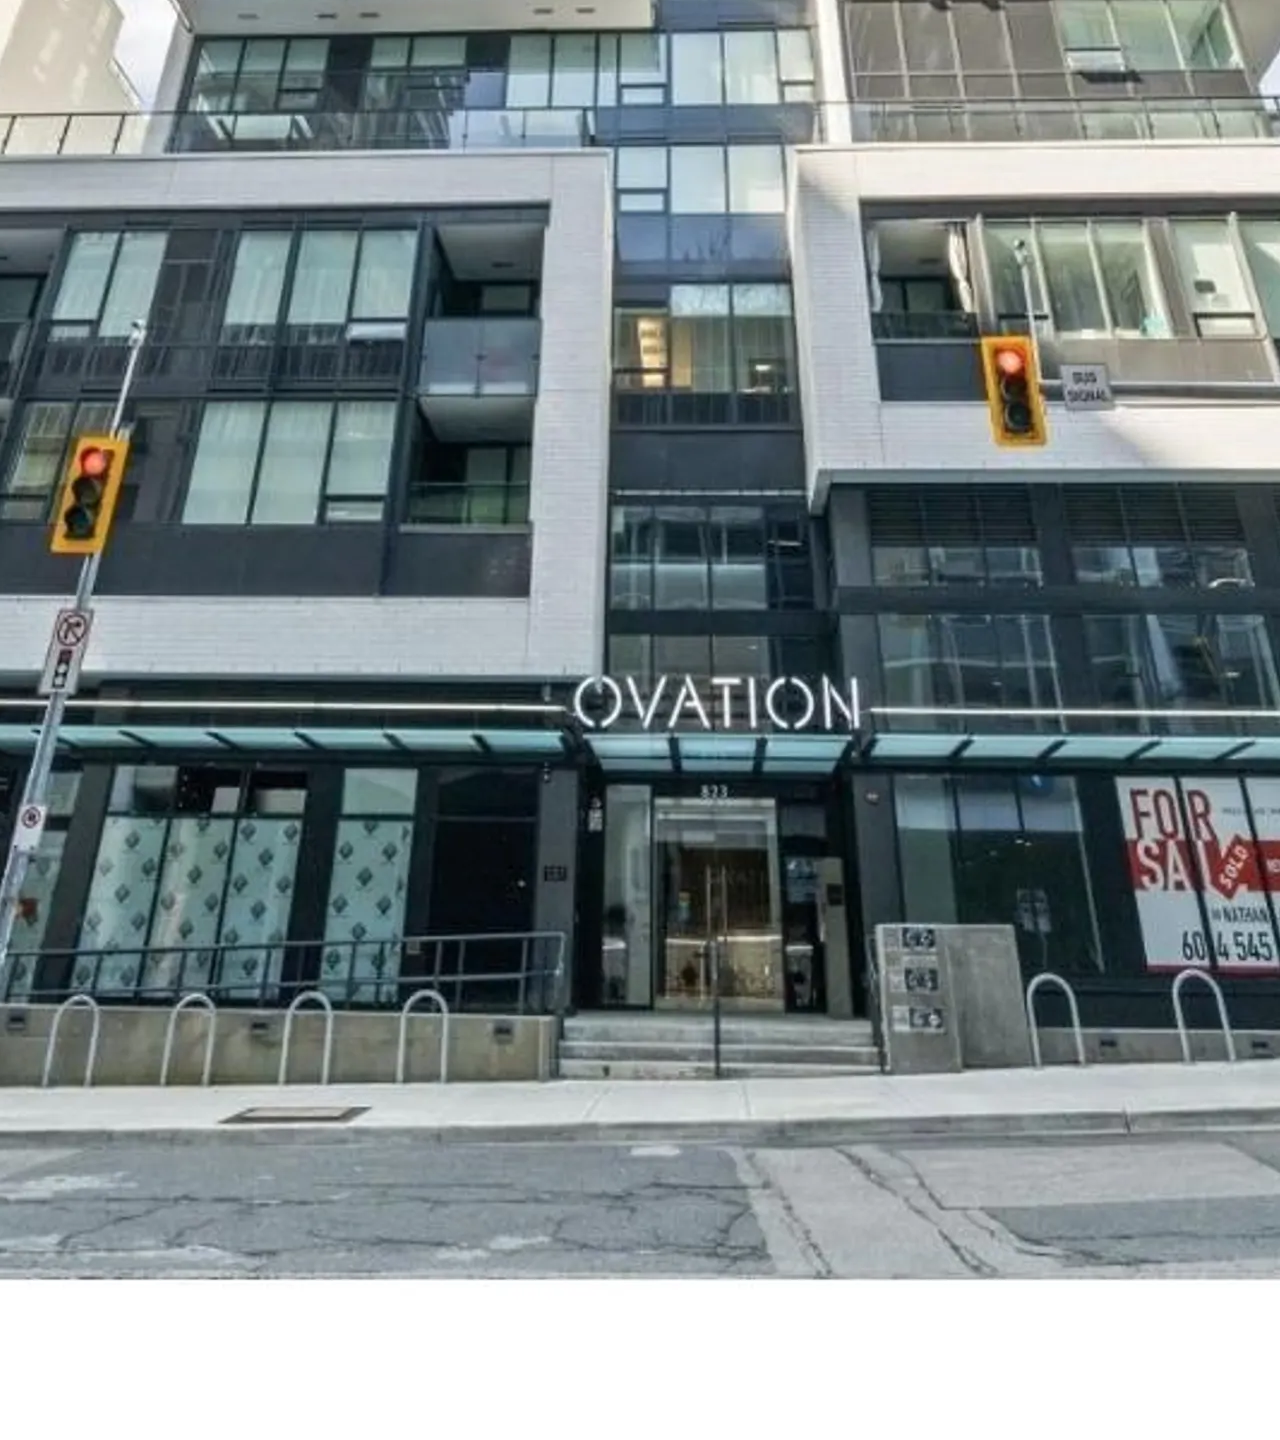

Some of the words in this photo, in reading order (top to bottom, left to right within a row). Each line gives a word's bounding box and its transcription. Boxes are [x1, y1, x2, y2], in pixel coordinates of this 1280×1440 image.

[1067, 389, 1108, 402] SIGNAL
[574, 673, 861, 729] OVATION
[1130, 788, 1219, 840] FOR
[1136, 838, 1249, 892] SAL
[1219, 845, 1249, 889] SOLD
[1222, 907, 1271, 923] NATHAN
[1182, 931, 1229, 961] 604
[1233, 931, 1273, 961] 545
